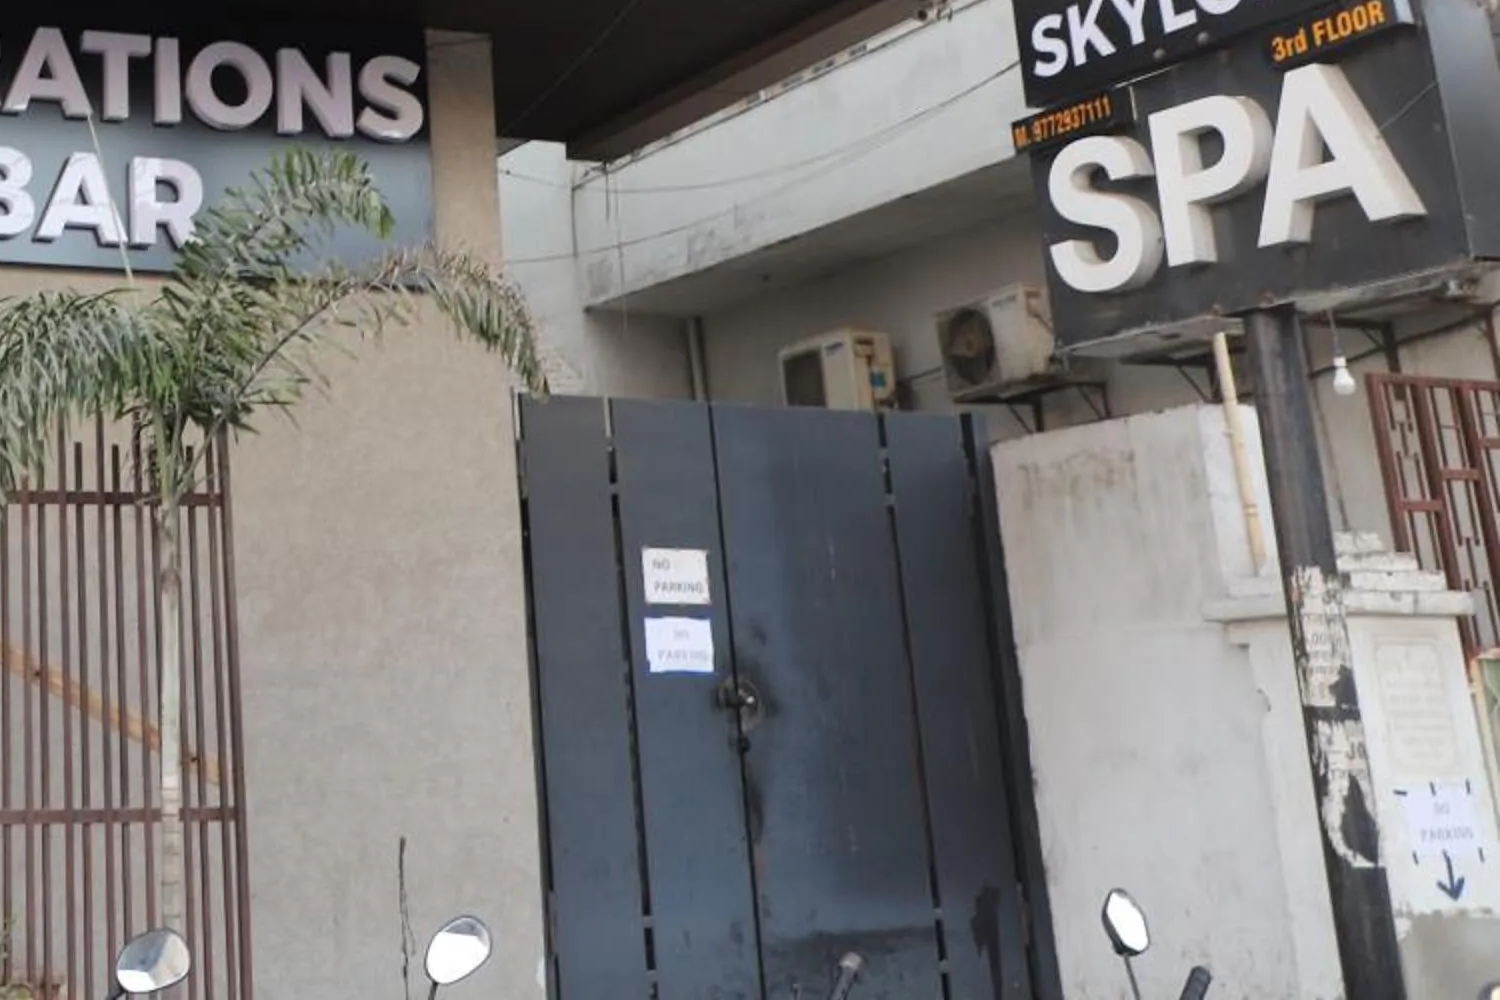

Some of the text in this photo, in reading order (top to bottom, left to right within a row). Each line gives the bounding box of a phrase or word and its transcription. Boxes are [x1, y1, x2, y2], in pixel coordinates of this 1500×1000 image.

[1271, 0, 1385, 62] 3rd FLOOR
[1049, 63, 1427, 291] SPA
[652, 558, 671, 570] NO
[653, 580, 704, 593] PARKING
